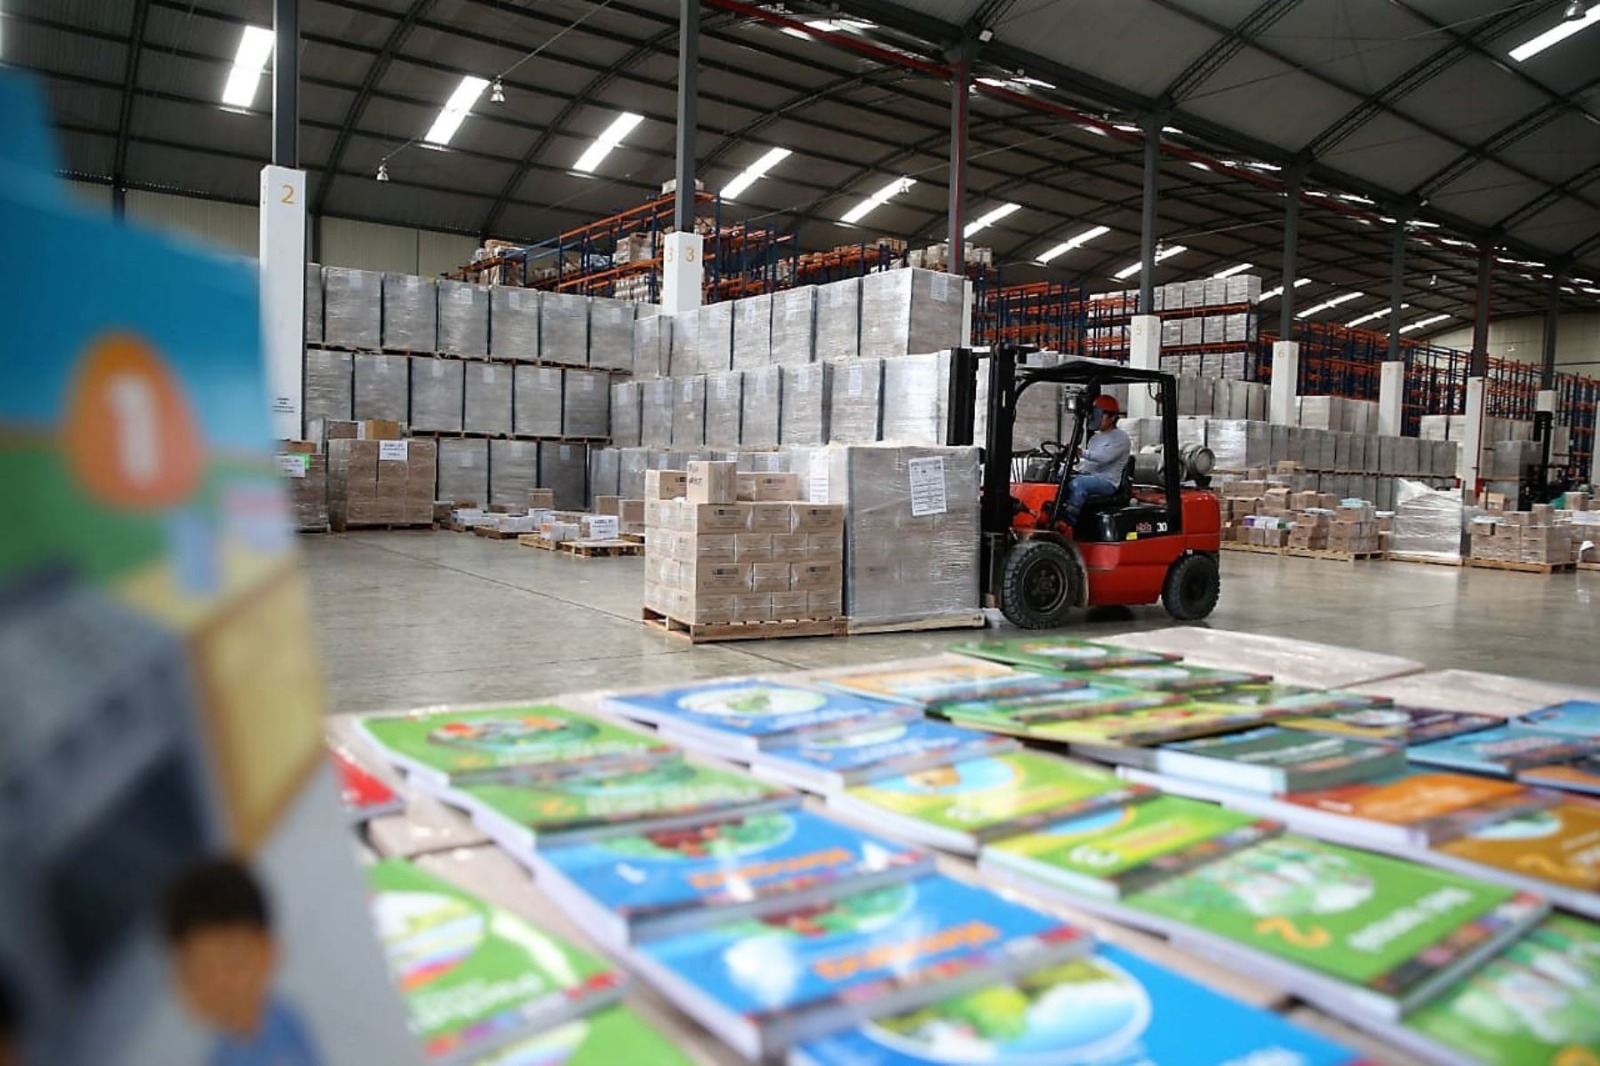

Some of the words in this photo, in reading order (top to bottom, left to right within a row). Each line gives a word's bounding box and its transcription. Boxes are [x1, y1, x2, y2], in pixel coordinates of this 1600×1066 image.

[280, 183, 296, 205] 2
[686, 246, 696, 263] 3
[106, 373, 163, 484] 1
[1156, 521, 1168, 532] 30
[1253, 914, 1332, 949] 2
